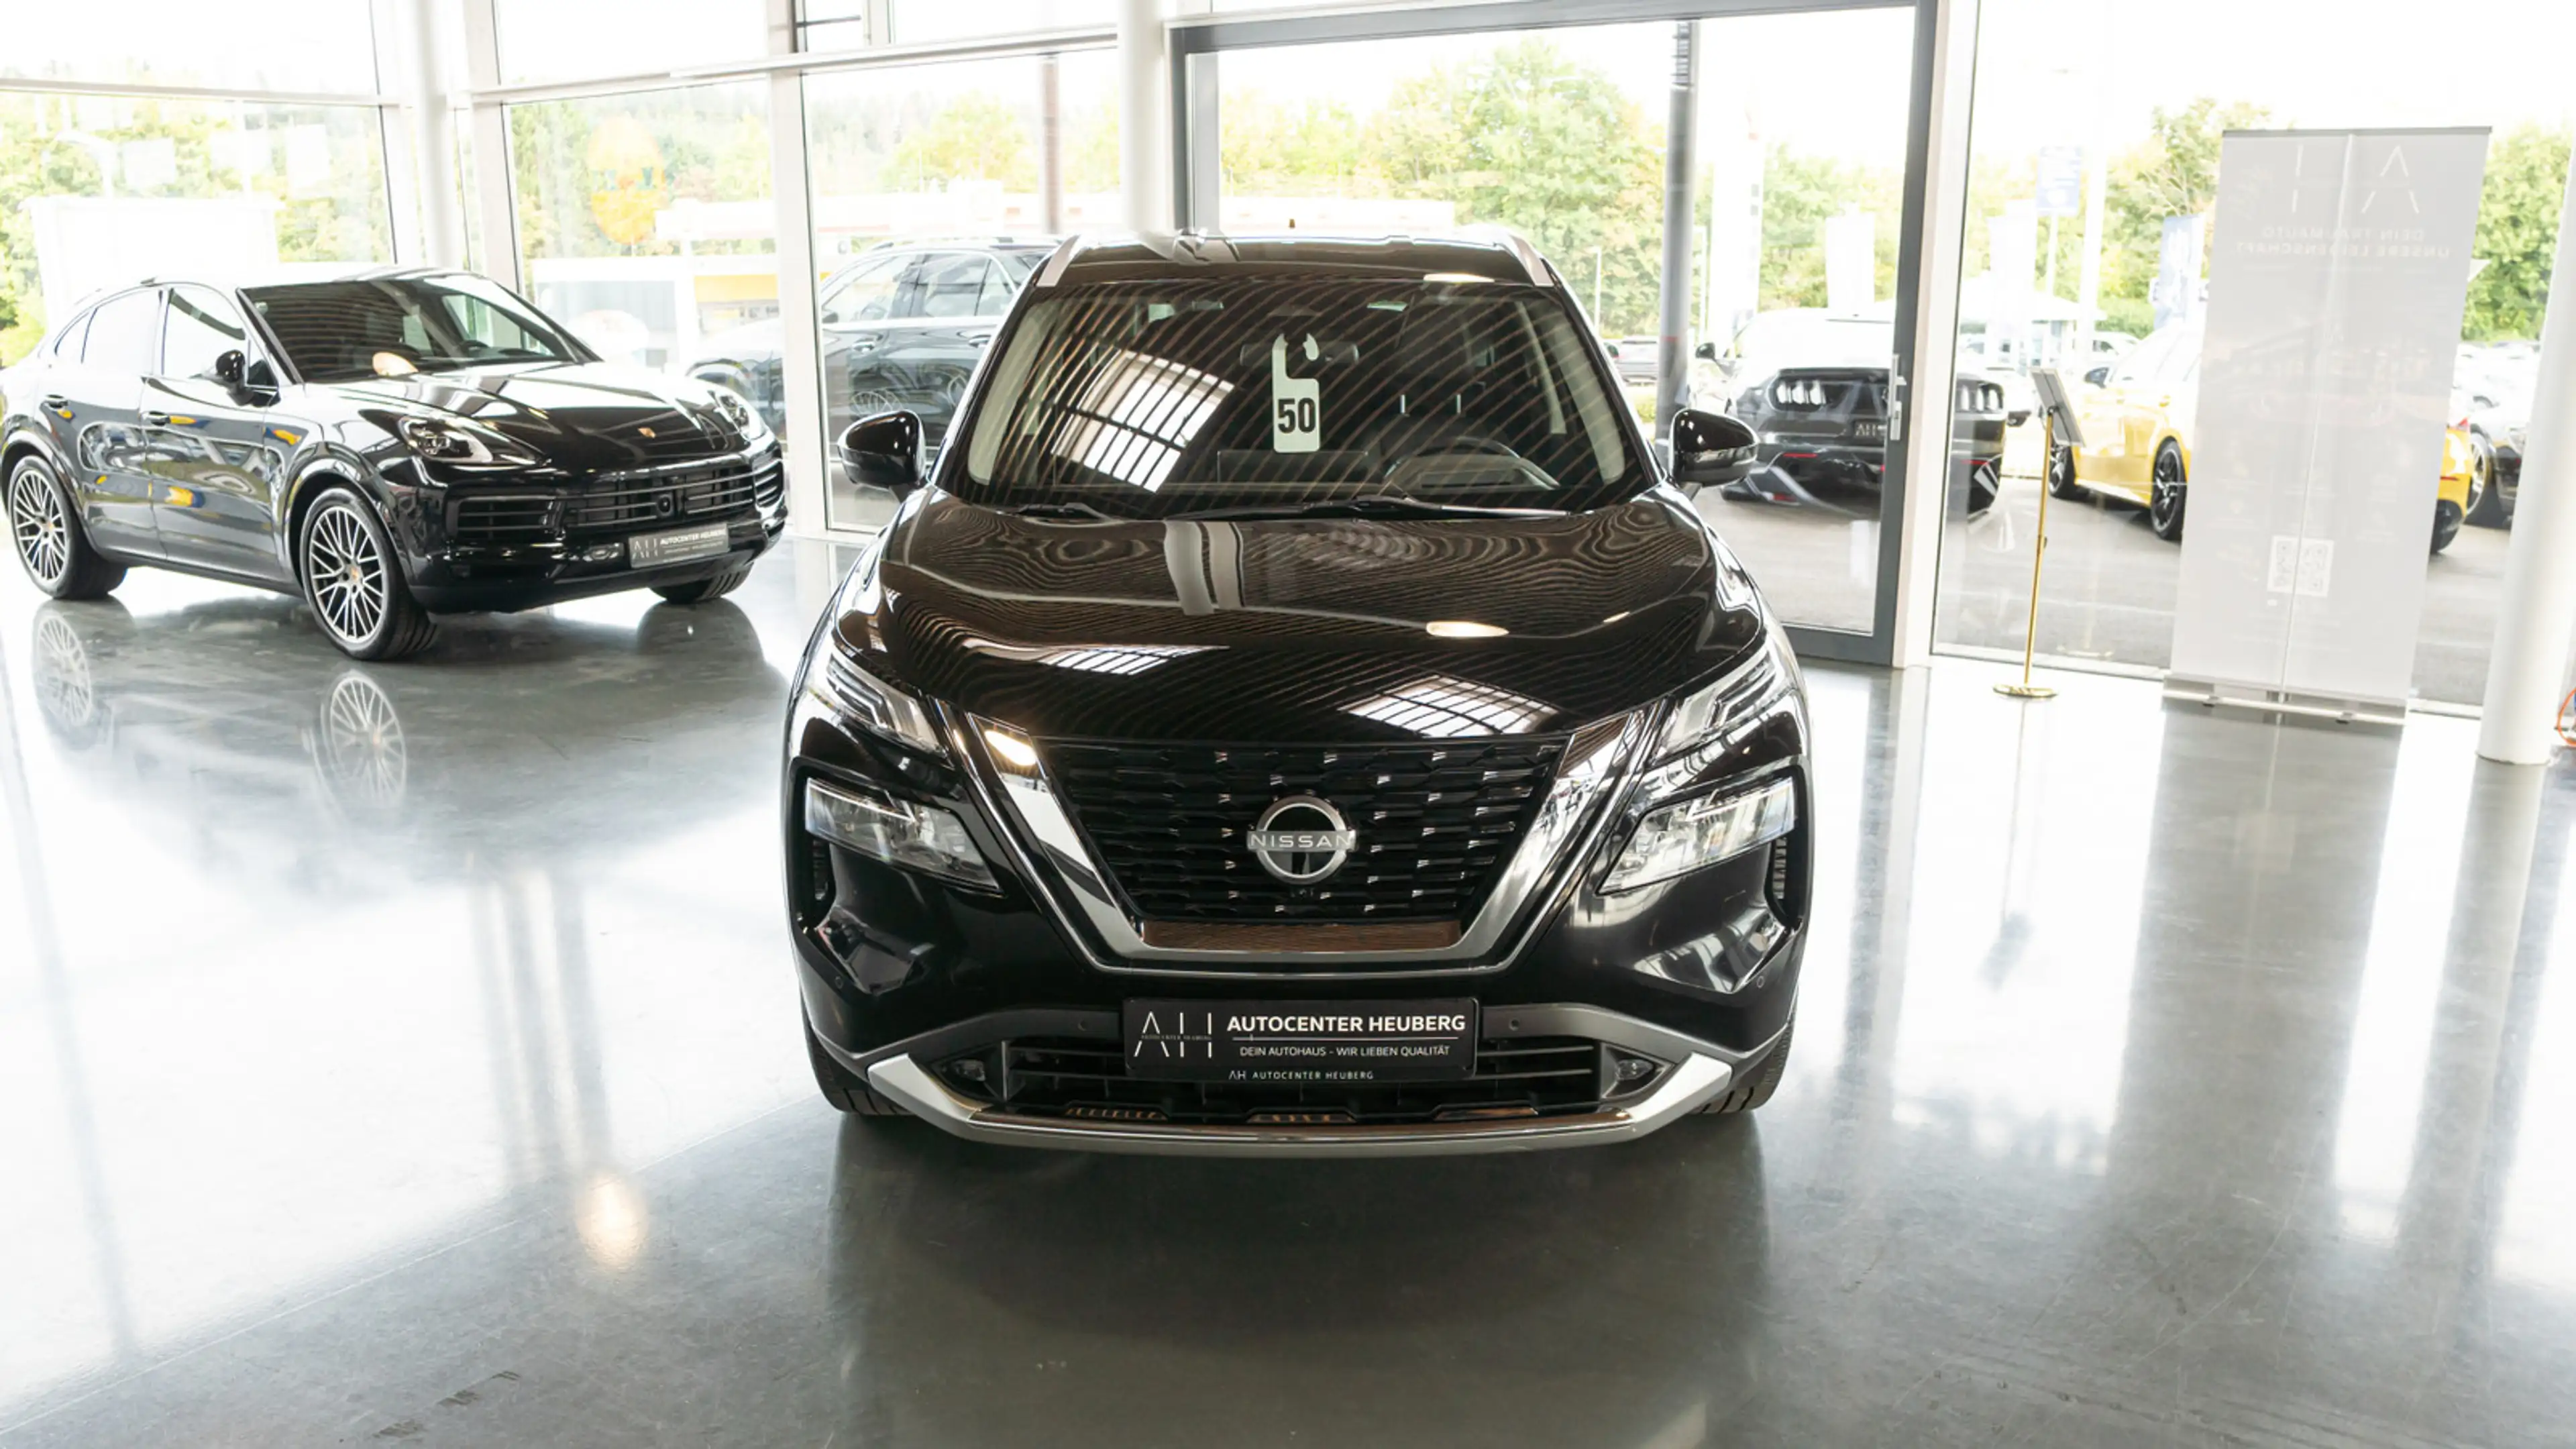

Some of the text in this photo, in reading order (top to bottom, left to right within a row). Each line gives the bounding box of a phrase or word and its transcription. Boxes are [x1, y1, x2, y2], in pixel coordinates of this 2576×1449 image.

[1278, 398, 1316, 433] 50
[1250, 835, 1351, 848] NISSAN
[1227, 1015, 1466, 1032] AUTOCENTER HEUBERG
[1134, 1011, 1212, 1059] AH
[1240, 1046, 1267, 1056] DEIN
[1268, 1046, 1326, 1057] AUTOHAUS
[1336, 1046, 1358, 1056] WIR
[1360, 1046, 1398, 1056] LIEBEN
[1401, 1044, 1450, 1057] QUALITÄT
[1252, 1071, 1321, 1079] AUTOCENTER
[1326, 1071, 1374, 1079] HEUBERG
